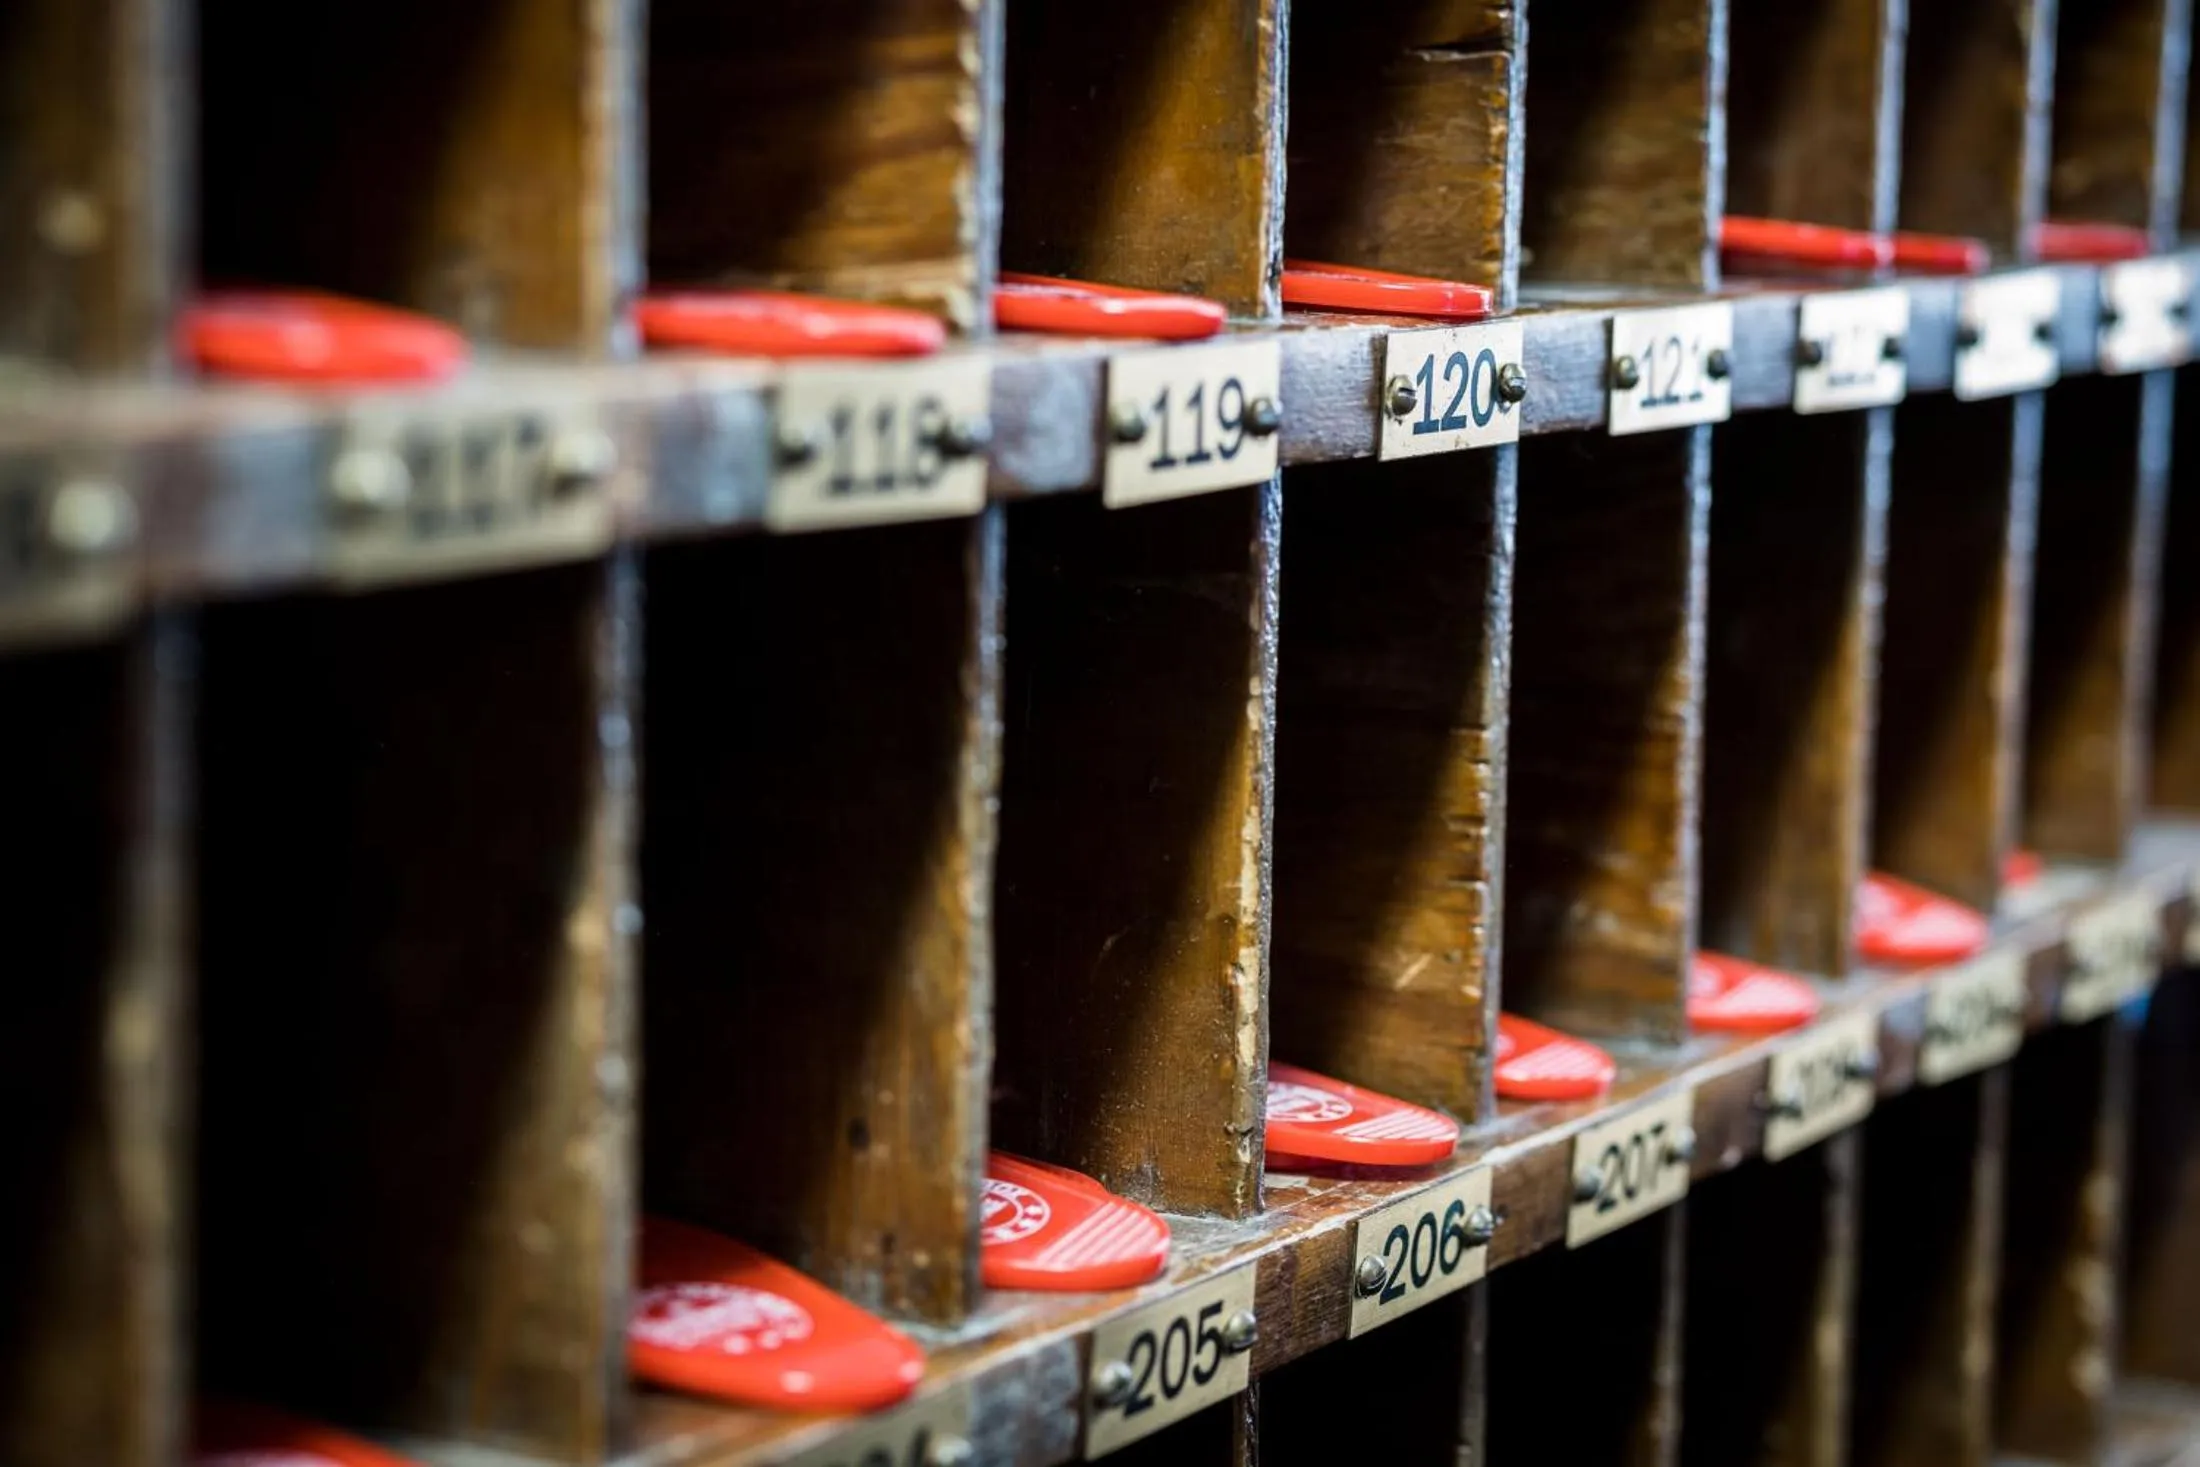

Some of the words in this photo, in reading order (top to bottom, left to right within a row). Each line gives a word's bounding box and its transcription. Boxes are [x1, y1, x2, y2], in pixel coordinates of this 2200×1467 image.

[1412, 348, 1498, 435] 120
[1640, 335, 1704, 408] 121
[1149, 376, 1246, 469] 119
[1596, 1120, 1668, 1214] 207
[1379, 1199, 1465, 1305] 206
[1123, 1300, 1225, 1418] 205
